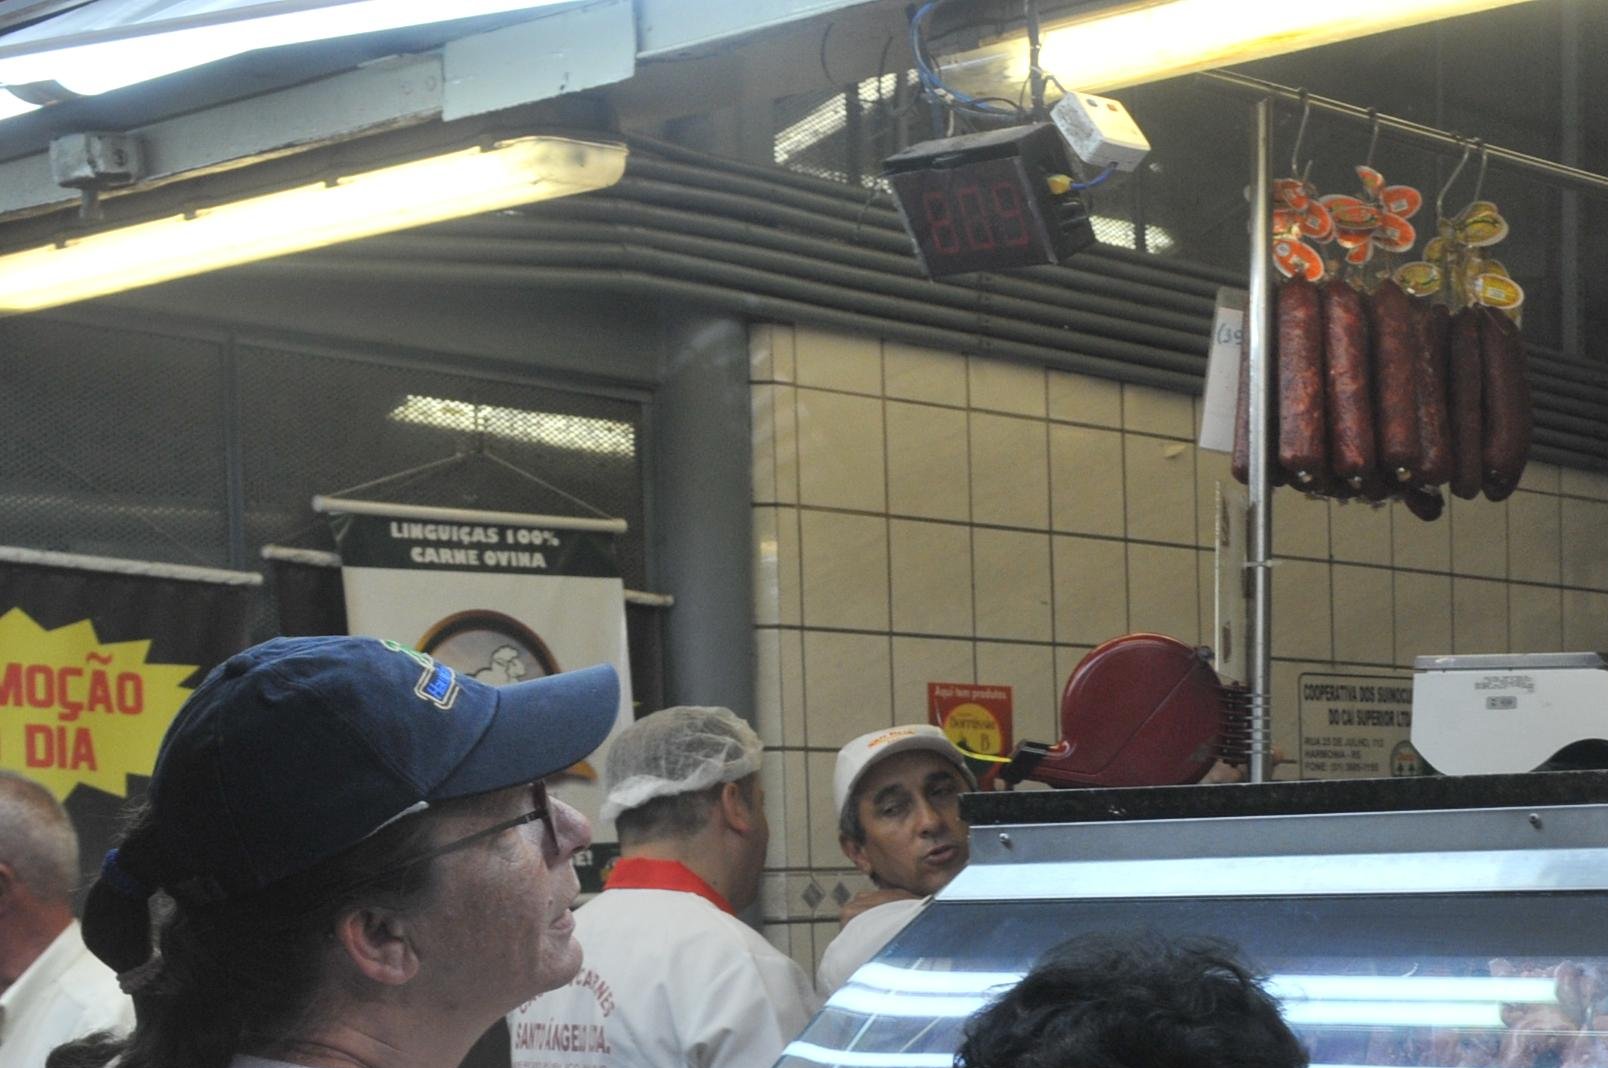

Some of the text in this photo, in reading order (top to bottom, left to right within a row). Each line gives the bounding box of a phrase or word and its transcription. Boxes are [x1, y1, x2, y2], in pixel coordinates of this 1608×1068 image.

[390, 522, 560, 547] LINGUIÇAS 100%
[410, 547, 548, 568] CARNE OVINA
[1304, 684, 1357, 701] COOPERATIVA
[1359, 686, 1375, 702] DOS
[1357, 709, 1394, 727] SUPERIOR
[25, 723, 97, 771] DIA
